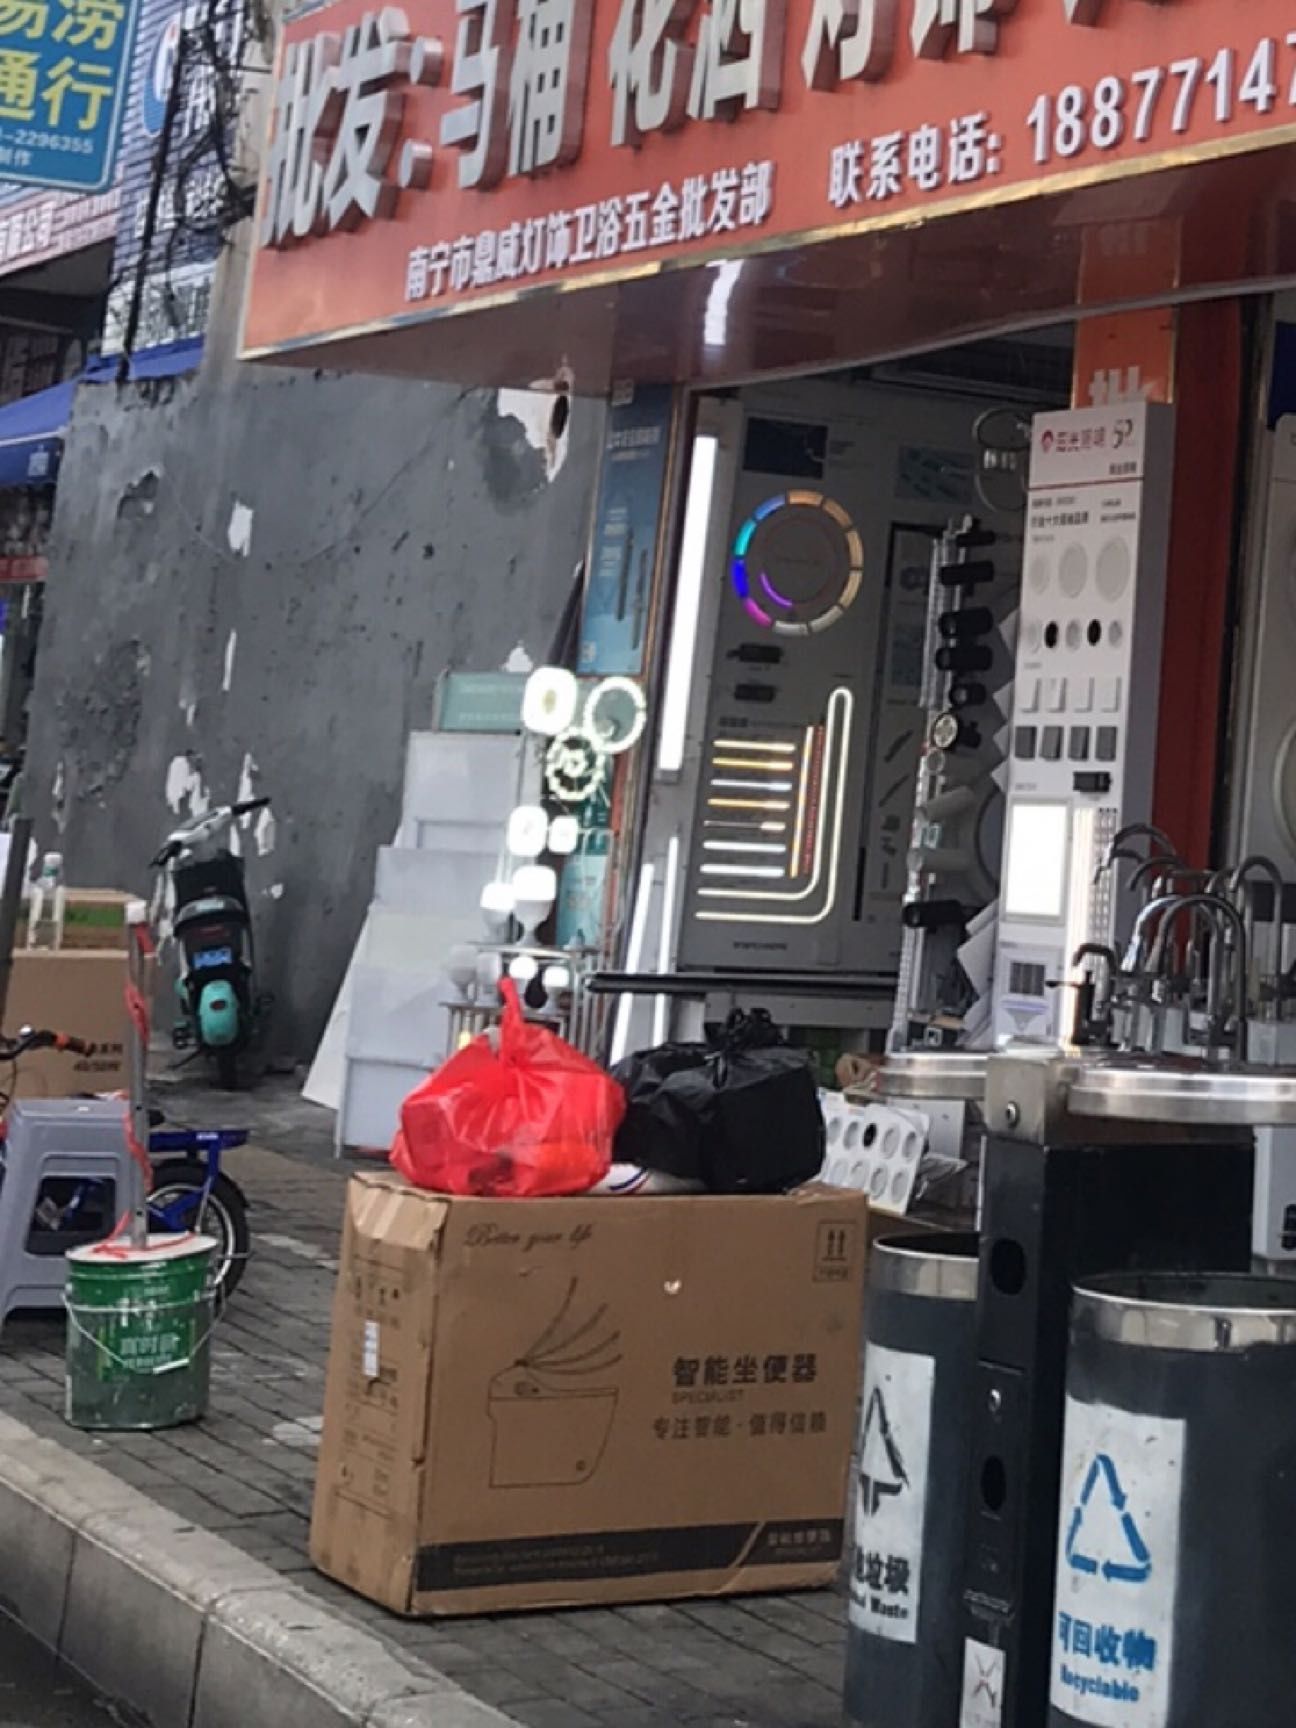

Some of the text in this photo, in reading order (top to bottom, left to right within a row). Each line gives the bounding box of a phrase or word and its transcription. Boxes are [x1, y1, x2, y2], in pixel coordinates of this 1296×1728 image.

[673, 1353, 817, 1388] 智能坐便器
